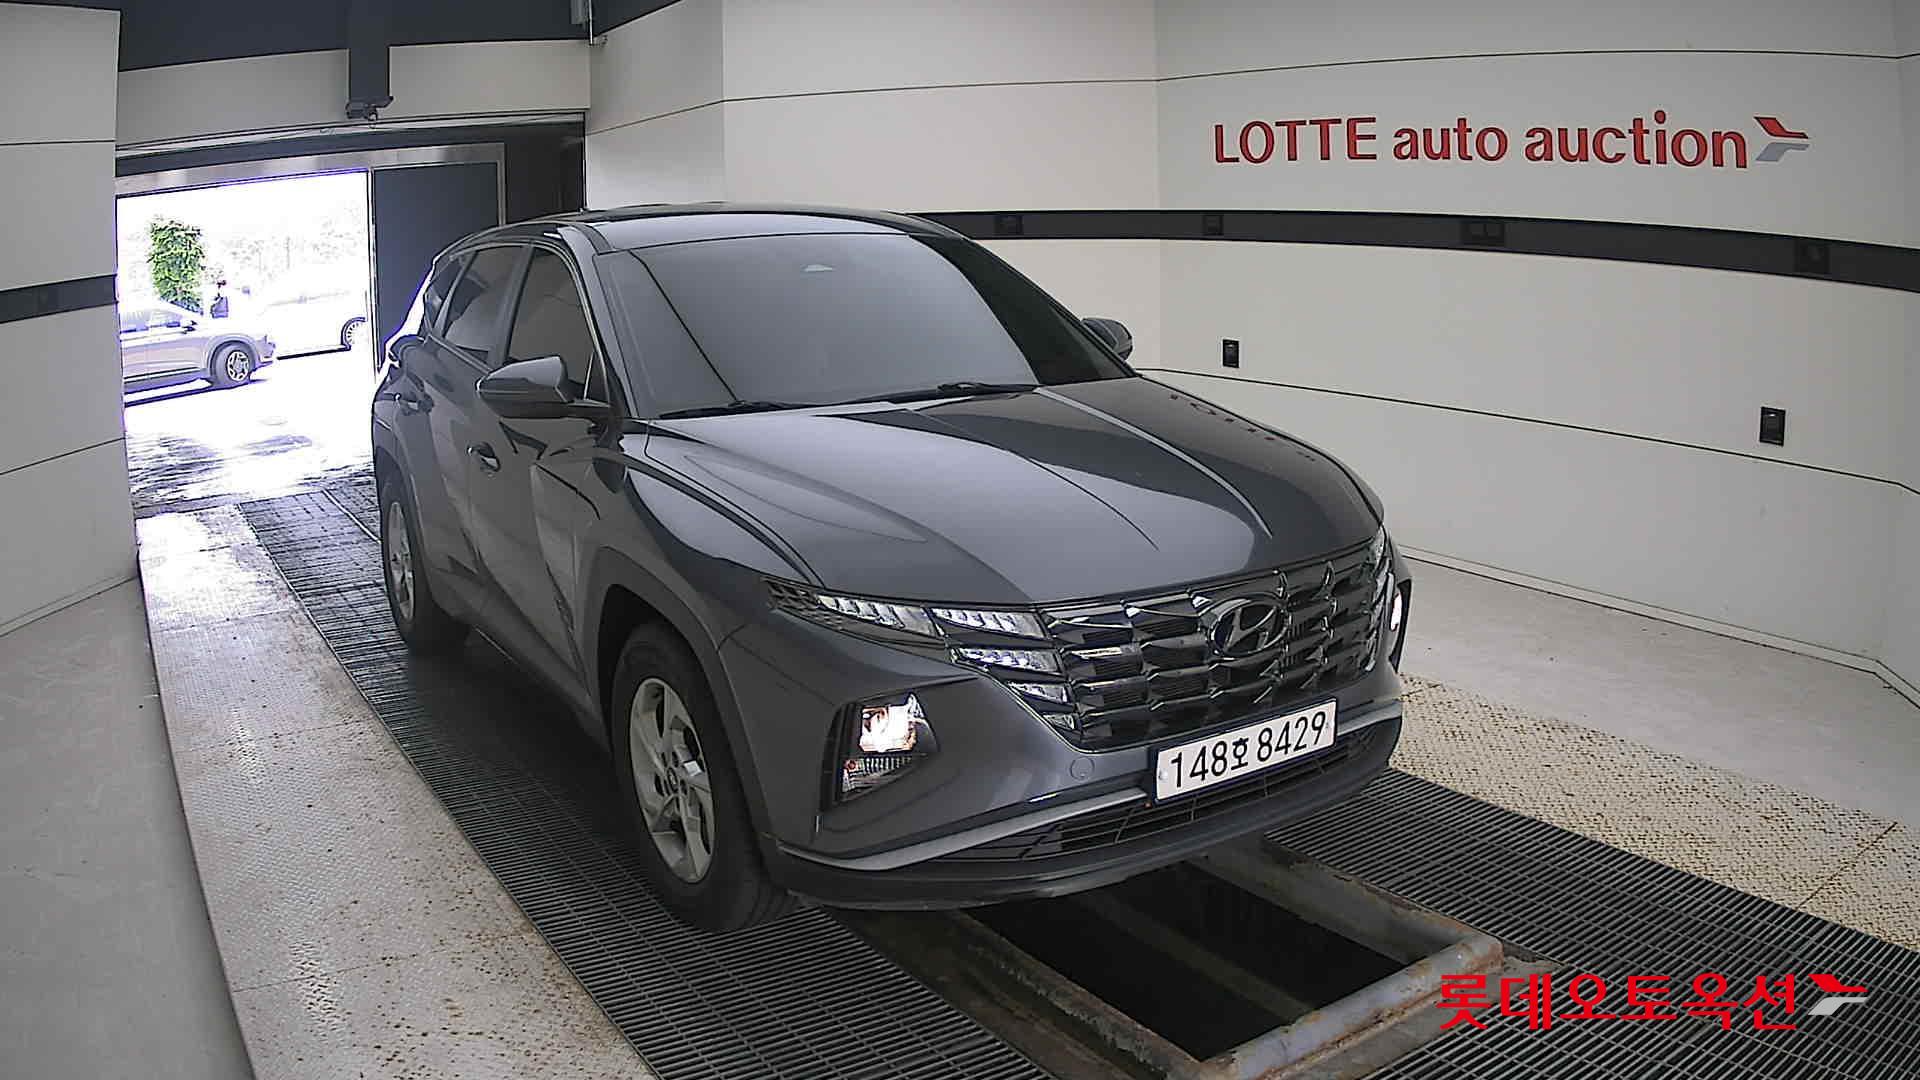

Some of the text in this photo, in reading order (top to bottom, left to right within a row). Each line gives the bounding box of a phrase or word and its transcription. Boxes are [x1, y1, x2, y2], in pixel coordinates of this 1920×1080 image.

[1214, 110, 1748, 168] LOTTE auto auction
[1256, 711, 1326, 762] 8429
